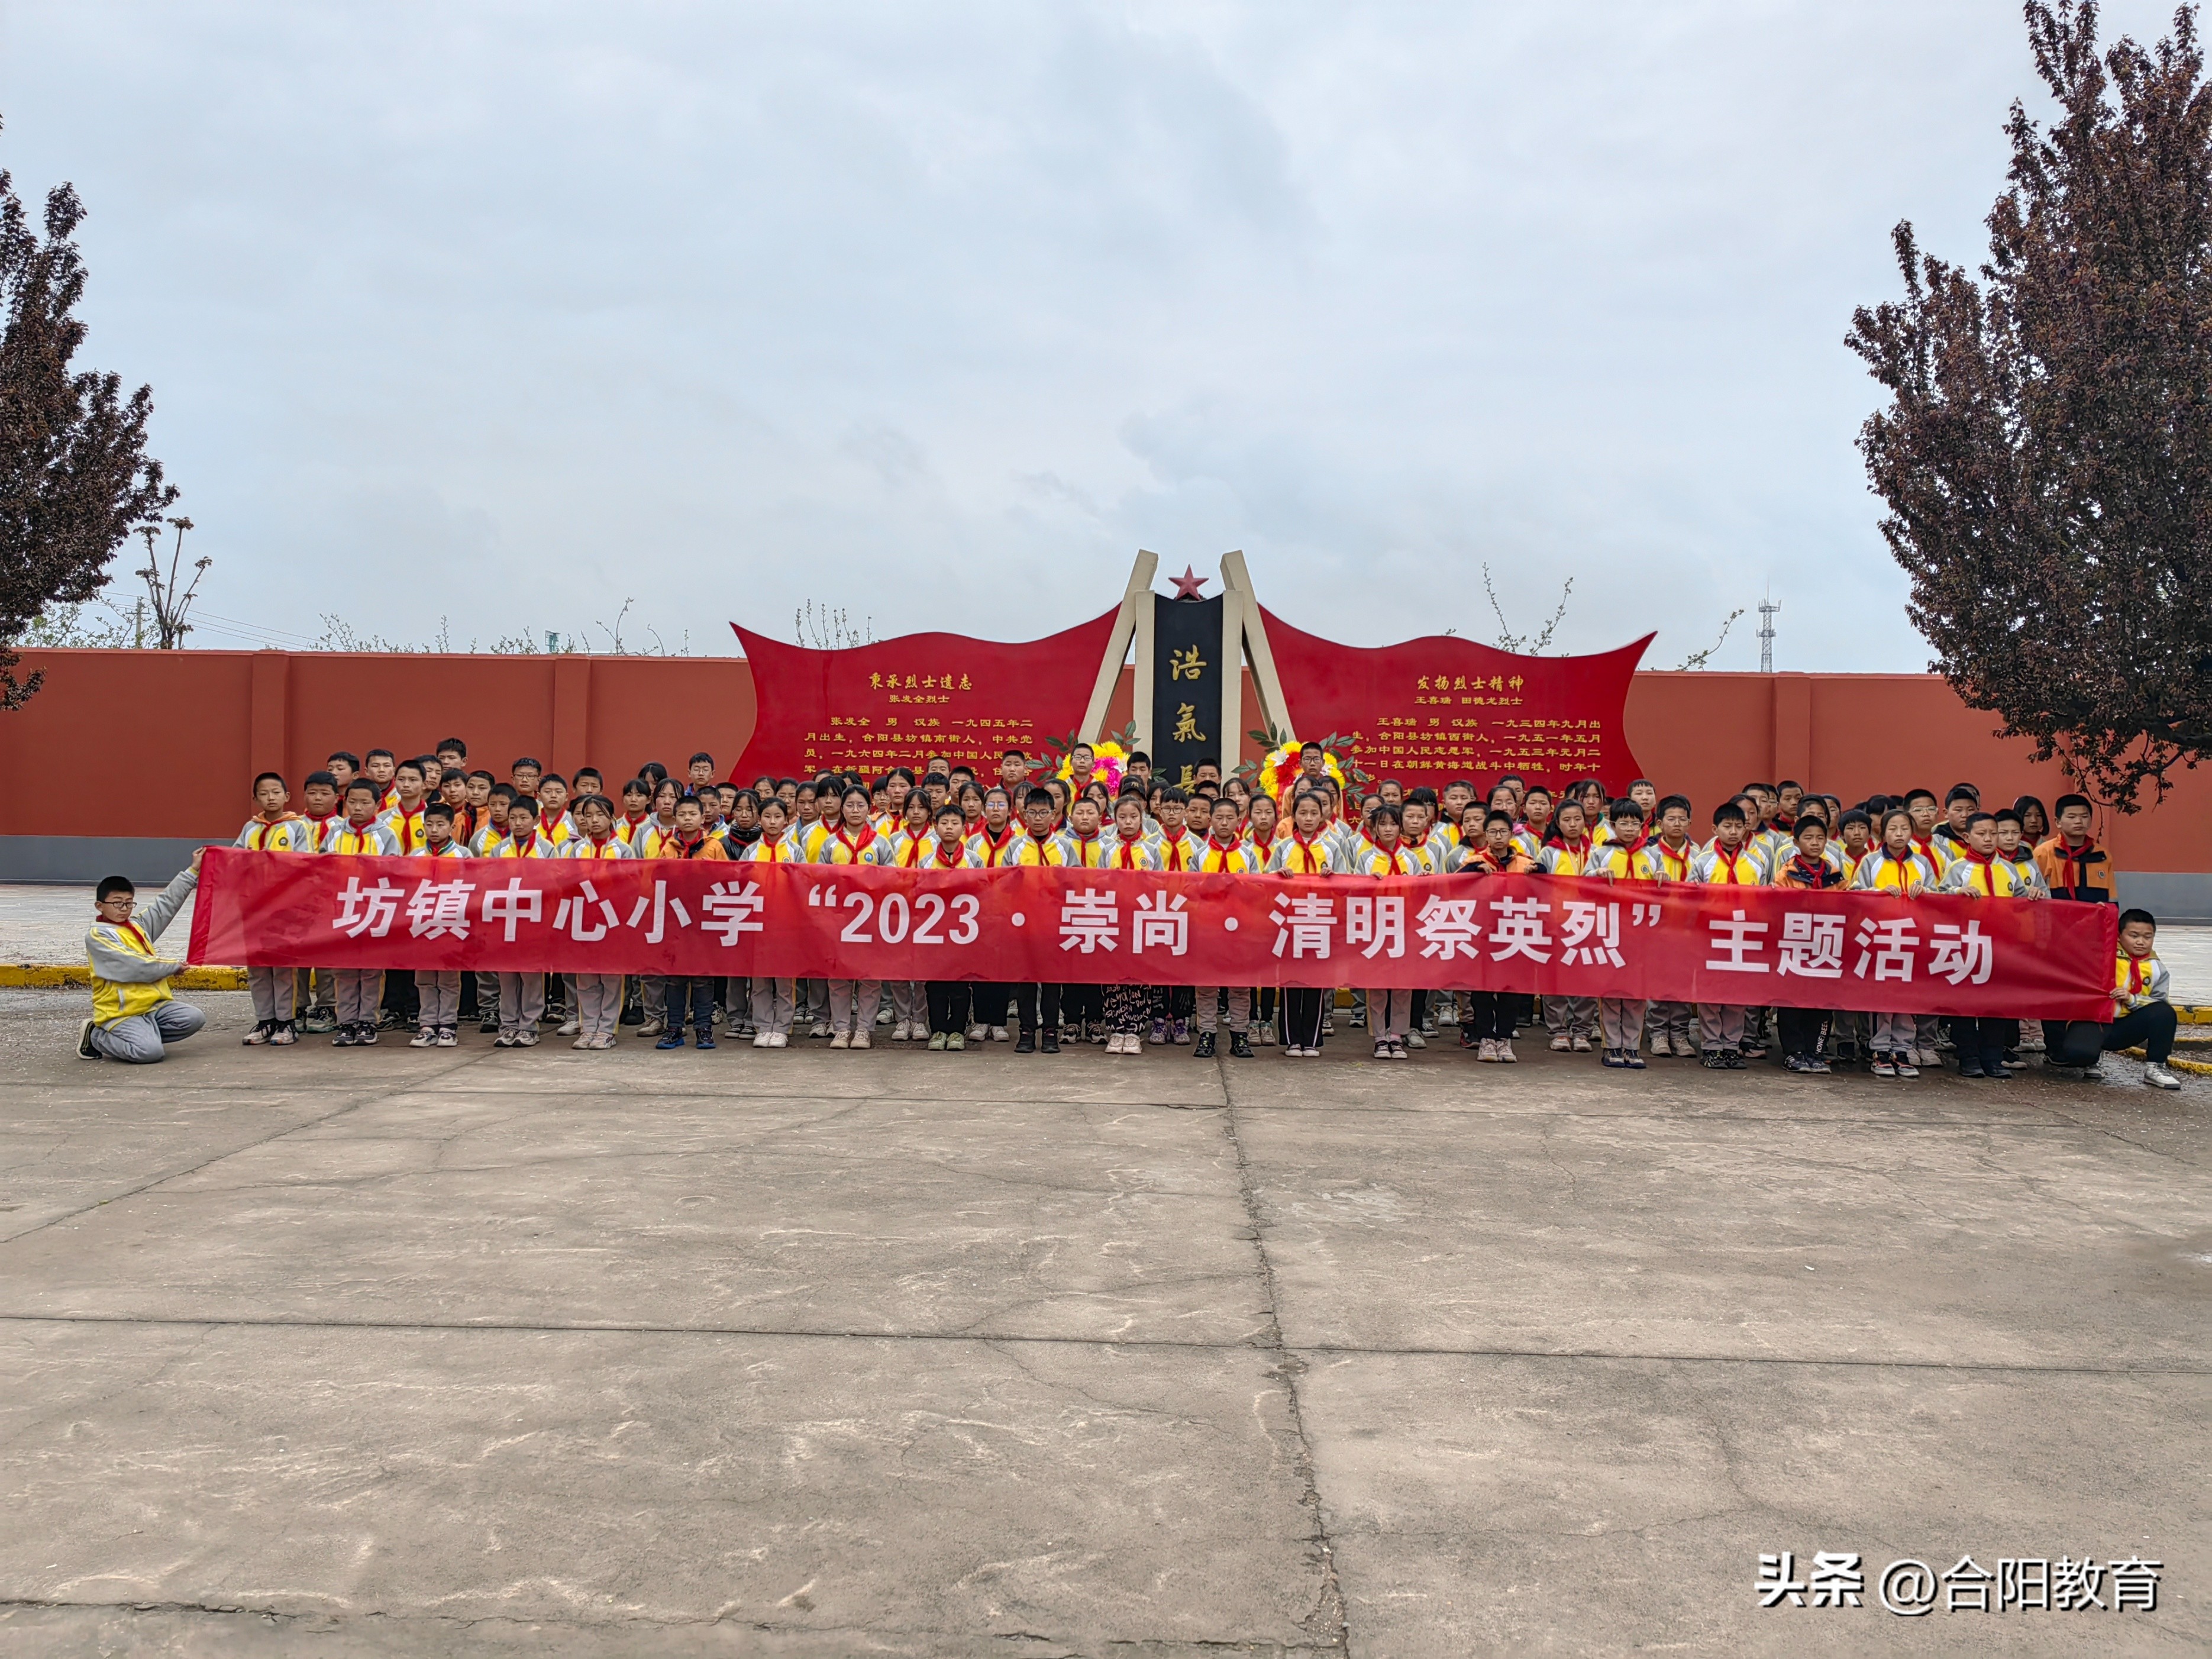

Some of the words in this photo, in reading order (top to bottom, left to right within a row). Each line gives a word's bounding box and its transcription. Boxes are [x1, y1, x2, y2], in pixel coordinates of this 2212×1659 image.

[868, 672, 972, 690] 秉承烈士遗志
[1417, 674, 1524, 692] 发扬烈士精神
[889, 694, 950, 703] 张发全烈士
[1414, 696, 1452, 705] 王喜瑞
[1461, 696, 1523, 705] 田德龙烈士
[830, 716, 870, 726] 张发全
[886, 718, 897, 727] 男
[913, 718, 940, 727] 汉族
[951, 718, 1033, 728] 一九四五年二
[1377, 717, 1417, 727] 王喜瑞
[1428, 718, 1440, 727] 男
[1451, 718, 1478, 727] 汉族
[1491, 719, 1600, 729] 一九三四年九月出
[332, 876, 764, 947] 坊镇中心小学
[1705, 909, 1993, 986] 主题活动
